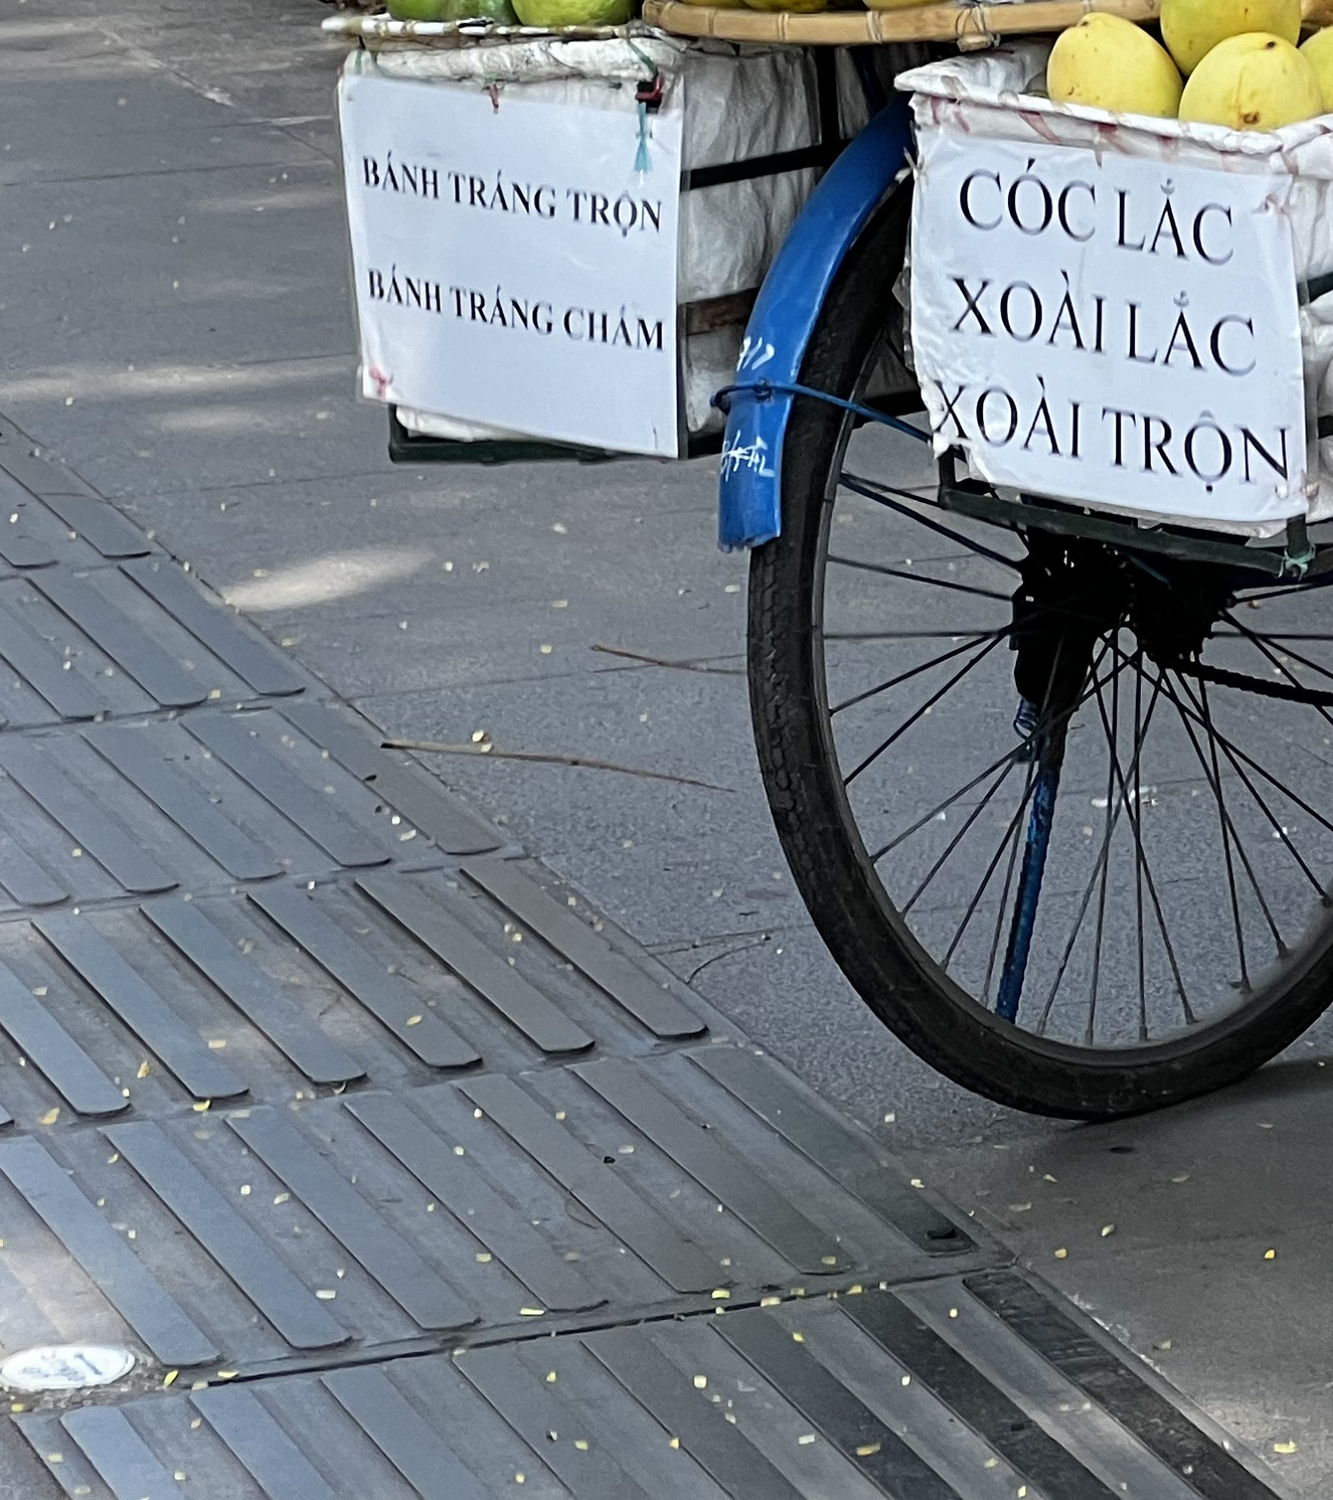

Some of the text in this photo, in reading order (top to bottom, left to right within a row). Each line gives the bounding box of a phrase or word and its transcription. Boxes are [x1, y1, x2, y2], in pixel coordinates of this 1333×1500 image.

[363, 150, 662, 238] BÁNH TRÁNG TRỘN
[959, 158, 1097, 243] CÓC
[368, 262, 442, 314] BÁNH
[450, 284, 553, 336] TRÁNG
[948, 269, 1108, 358] XOÀI
[933, 373, 1292, 494] XOÀI TRỘN
